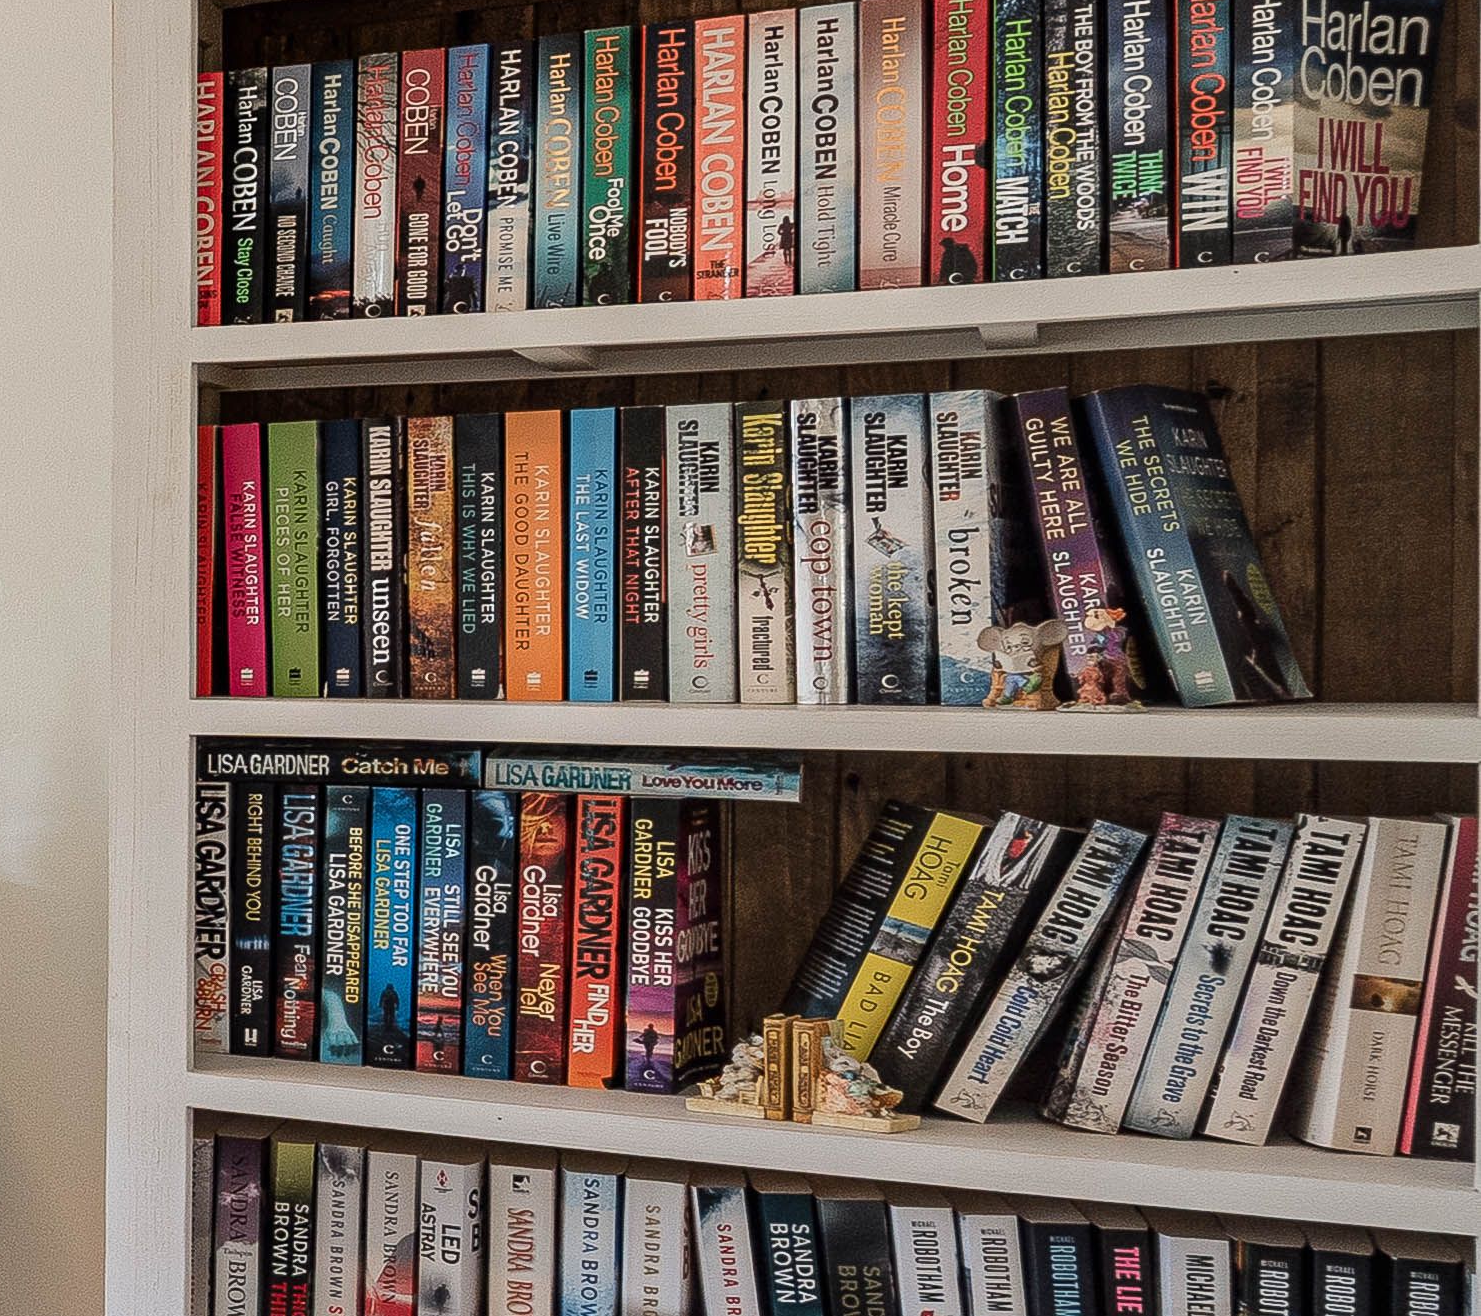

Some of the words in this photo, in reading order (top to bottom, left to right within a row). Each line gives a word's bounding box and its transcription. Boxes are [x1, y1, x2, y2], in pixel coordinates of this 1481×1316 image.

[1074, 4, 1093, 38] THE
[595, 35, 620, 103] Harlan
[1074, 39, 1094, 72] BOY
[1300, 45, 1424, 107] Coben
[701, 27, 735, 147] HARLAN
[946, 69, 973, 137] Coben
[1074, 73, 1094, 127] FROM
[593, 106, 621, 177] Coben
[1190, 73, 1225, 163] Coben
[1075, 128, 1094, 161] THE
[1318, 117, 1325, 169] I
[1329, 118, 1389, 175] WILL
[607, 177, 624, 209] Fool
[940, 144, 976, 233] Home
[1112, 150, 1137, 201] TWICE
[1138, 150, 1164, 195] THINK
[447, 190, 465, 219] Let
[699, 153, 735, 253] COBEN
[995, 177, 1030, 245] MATCH
[1075, 162, 1095, 231] WOODS
[1181, 167, 1228, 233] WIN
[1299, 170, 1348, 226] FIND
[1356, 175, 1412, 228] YOU
[445, 223, 461, 253] Go
[460, 207, 483, 263] Don't
[497, 217, 515, 271] PROMISE
[588, 205, 609, 261] Once
[607, 209, 623, 237] Me
[645, 219, 662, 261] FOOL
[237, 237, 254, 265] Stay
[236, 267, 250, 303] Close
[497, 275, 513, 293] ME
[369, 425, 391, 476] KARIN
[514, 451, 529, 485] THE
[678, 419, 700, 517] SLAUGHTER
[699, 441, 719, 493] KARIN
[293, 469, 309, 527] KARIN
[461, 463, 476, 505] THIS
[276, 487, 291, 548] PIECES
[369, 479, 393, 571] SLAUGHTER
[462, 508, 476, 519] IS
[515, 493, 529, 546] GOOD
[276, 554, 291, 577] OF
[462, 524, 476, 563] WHY
[294, 531, 310, 634] SLAUGHTER
[462, 567, 476, 593] WE
[685, 563, 711, 619] pretty
[886, 560, 906, 591] the
[947, 526, 982, 627] broken
[1176, 569, 1208, 626] KARIN
[277, 584, 291, 617] HER
[371, 577, 391, 665] unseen
[462, 598, 476, 634] LIED
[515, 554, 530, 651] DAUGHTER
[869, 564, 884, 636] woman
[886, 592, 906, 640] kept
[1146, 548, 1192, 655] SLAUGHTER
[687, 622, 715, 668] girls
[207, 753, 248, 775] LISA
[250, 754, 330, 776] GARDNER
[341, 757, 409, 775] Catch
[413, 758, 450, 775] Me
[246, 793, 263, 835] RIGHT
[245, 837, 262, 888] BEHIND
[395, 824, 411, 857] ONE
[328, 853, 347, 892] LISA
[394, 859, 410, 898] STEP
[904, 834, 952, 901] HOAG
[244, 891, 262, 922] YOU
[394, 901, 410, 933] TOO
[472, 866, 498, 951] Gardner
[493, 882, 511, 915] Lisa
[325, 894, 346, 976] GARDNER
[631, 906, 651, 986] GOODBYE
[654, 908, 675, 947] KISS
[293, 944, 310, 978] Fear
[392, 936, 409, 968] FAR
[653, 950, 673, 987] HER
[280, 977, 300, 1039] Nothing
[587, 983, 610, 1026] FIND
[860, 969, 892, 1014] BAD
[919, 997, 950, 1027] The
[572, 1019, 595, 1054] HER
[897, 1026, 933, 1060] Boy
[419, 1203, 437, 1263] ASTRAY
[581, 1177, 600, 1254] SANDRA
[441, 1223, 461, 1265] LED
[1113, 1246, 1140, 1280] THE
[1116, 1285, 1143, 1313] LIE
